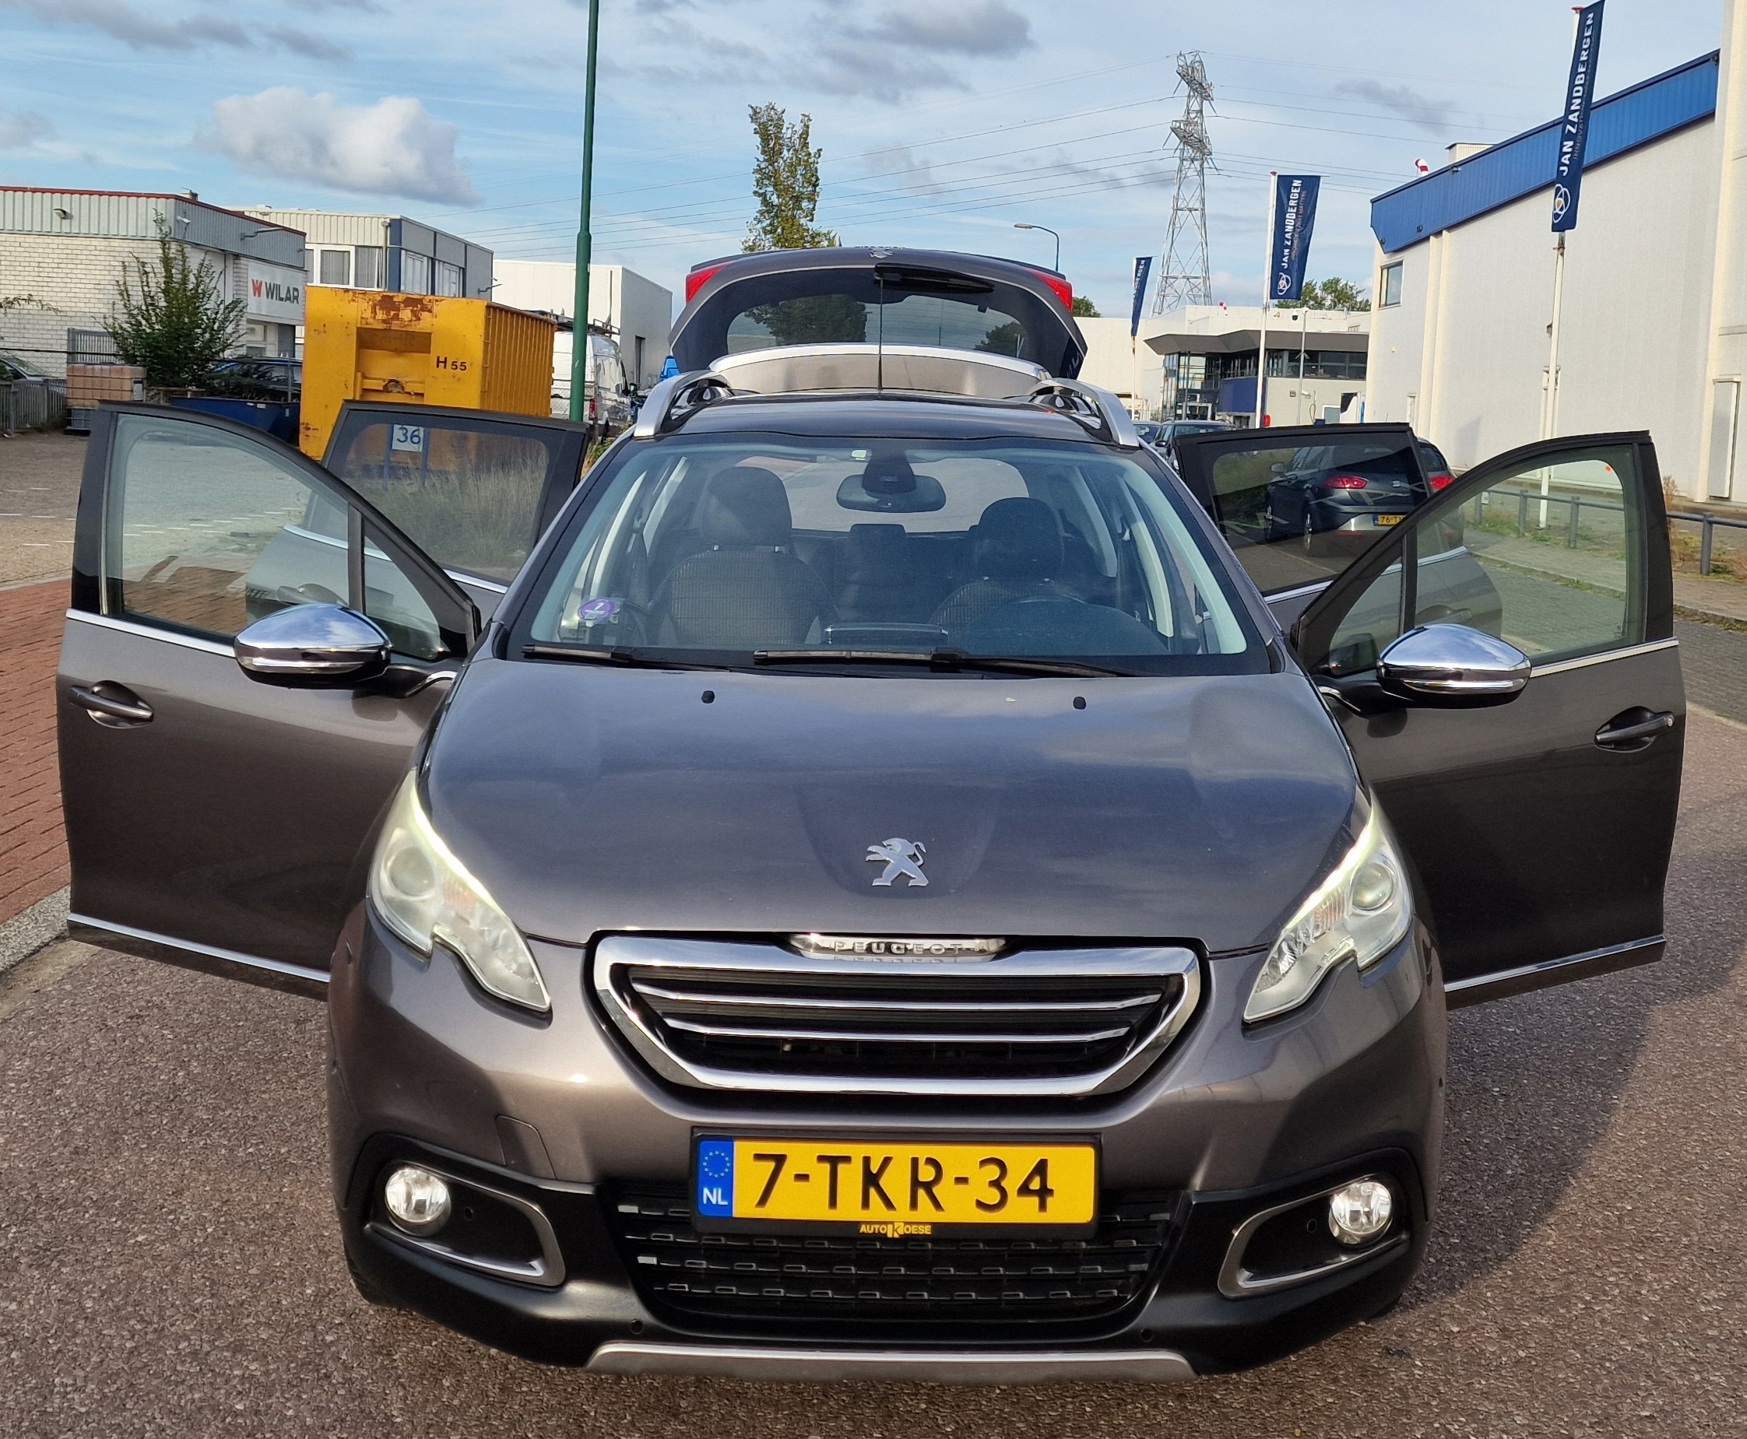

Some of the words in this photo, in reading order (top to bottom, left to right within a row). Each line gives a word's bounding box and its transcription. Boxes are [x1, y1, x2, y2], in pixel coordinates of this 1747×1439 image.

[1565, 12, 1594, 134] ZANDBERGEN
[1559, 140, 1574, 176] JAN
[1284, 179, 1302, 246] ZANDBERGEN
[1281, 249, 1290, 269] JAN
[264, 281, 300, 305] WILAR
[435, 355, 448, 370] H
[450, 360, 467, 372] 55
[396, 426, 422, 445] 36
[834, 941, 963, 955] PEUGEOT
[752, 1152, 1055, 1214] 7-TKR-34
[702, 1187, 729, 1206] NL
